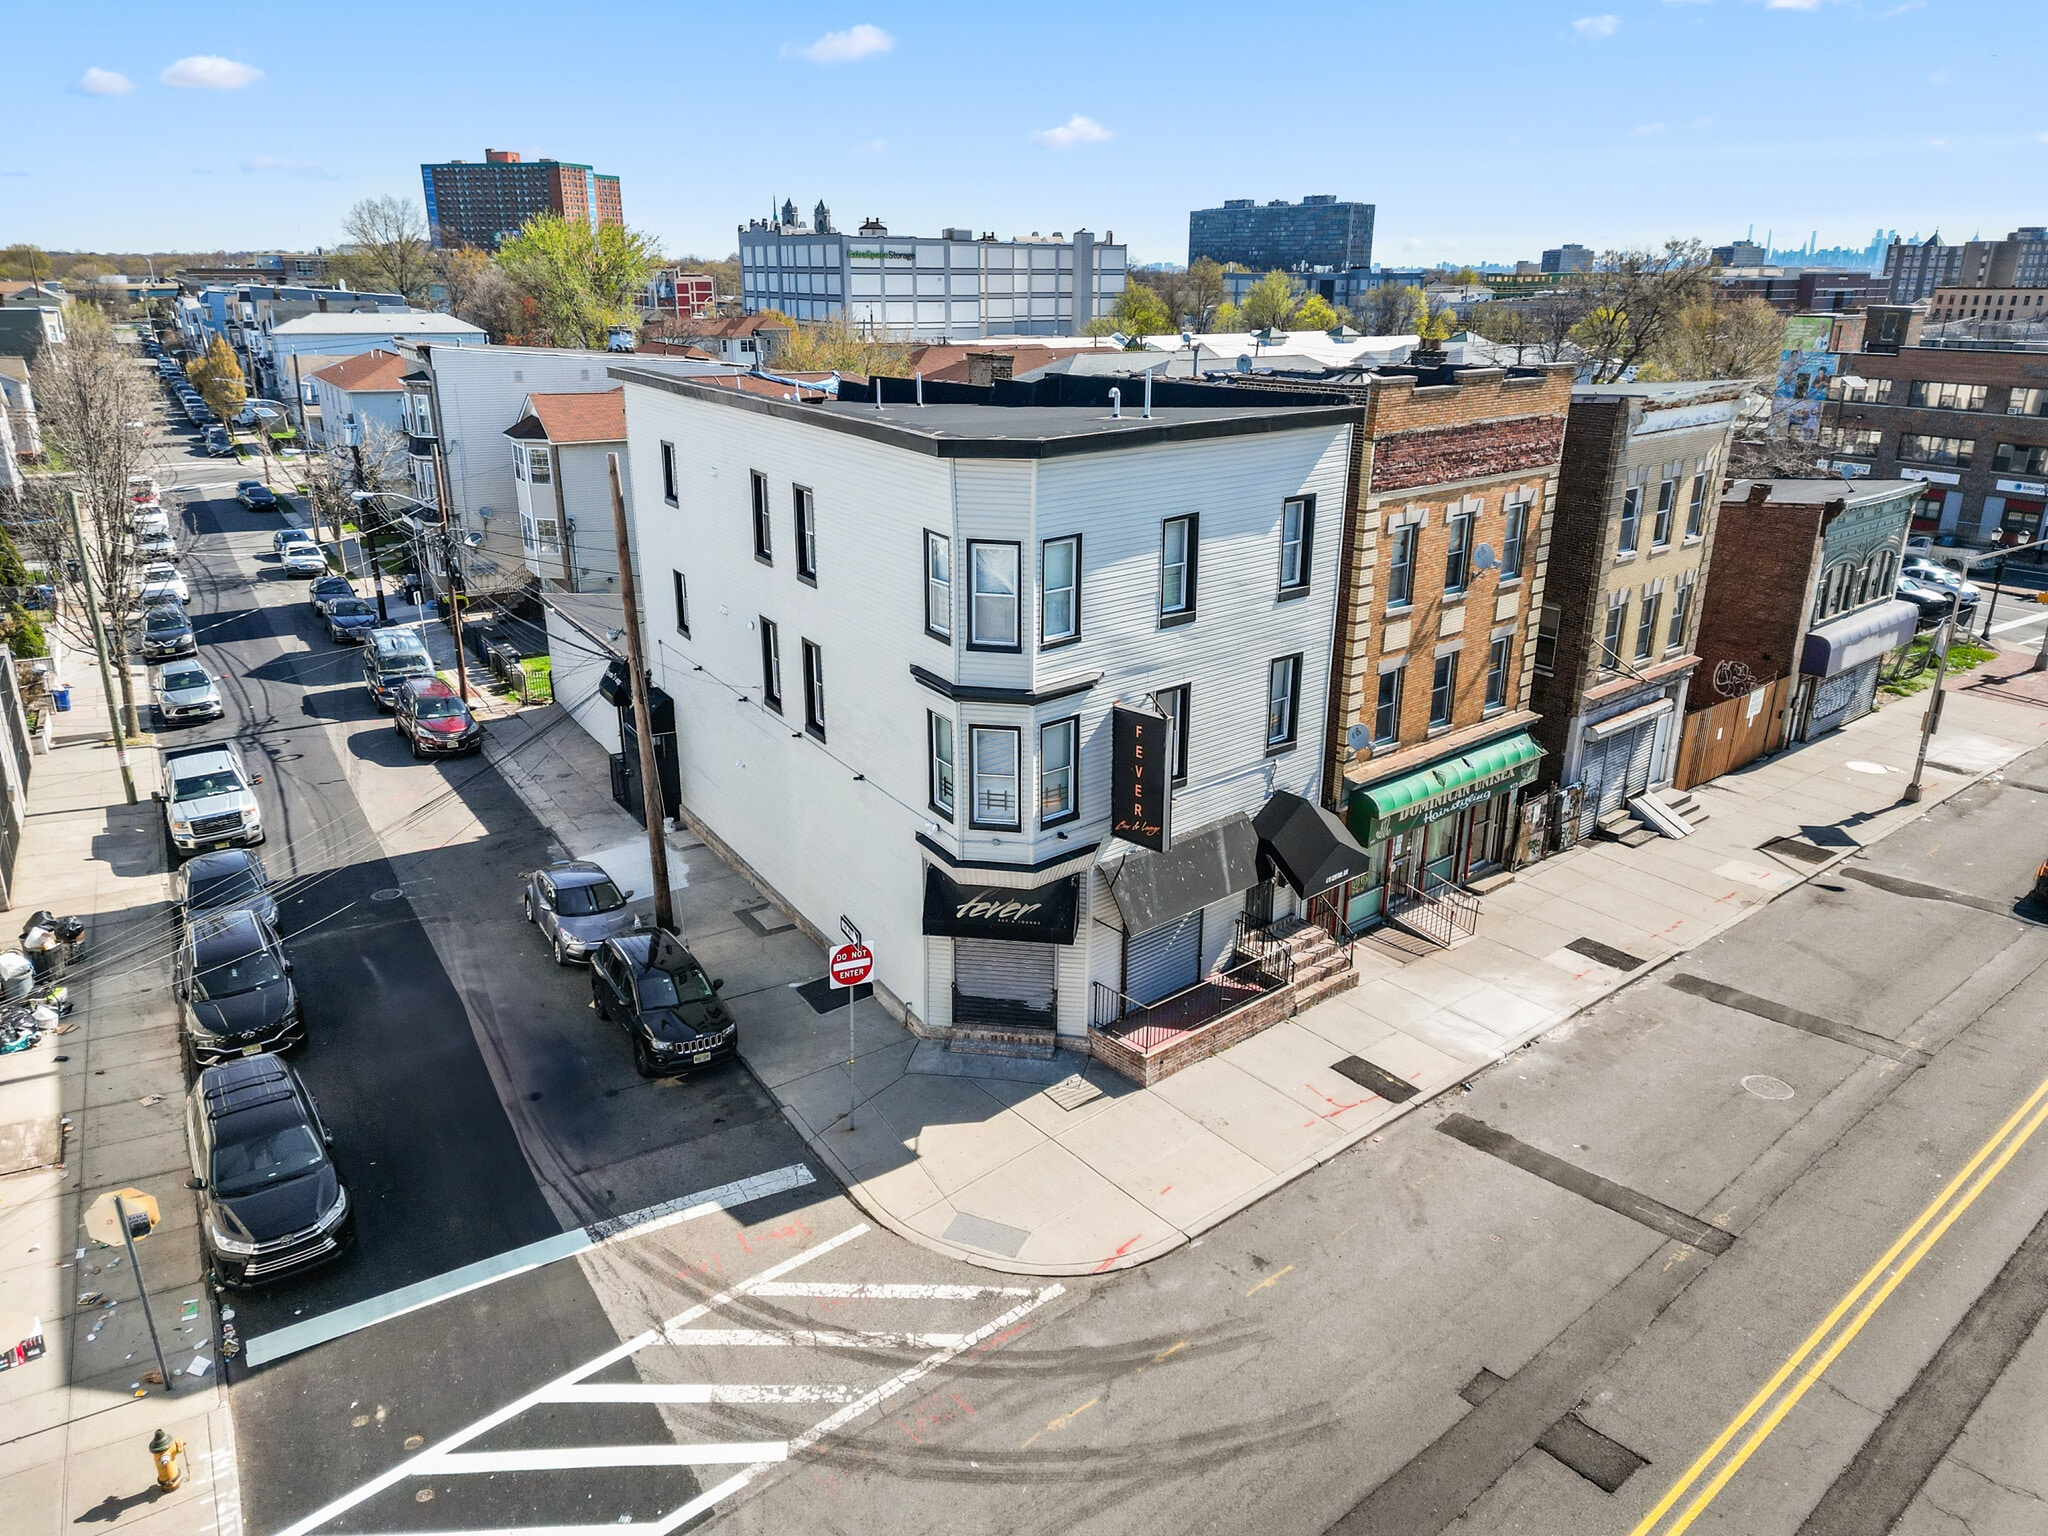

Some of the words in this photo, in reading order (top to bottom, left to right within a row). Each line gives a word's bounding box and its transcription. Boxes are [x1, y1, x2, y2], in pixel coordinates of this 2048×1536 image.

[1134, 725, 1143, 817] FEVER
[1398, 786, 1471, 822] DOMINICAN
[1423, 790, 1491, 824] Hairstyling
[836, 953, 847, 962] DO
[851, 950, 867, 959] NOT
[840, 968, 864, 979] ENTER
